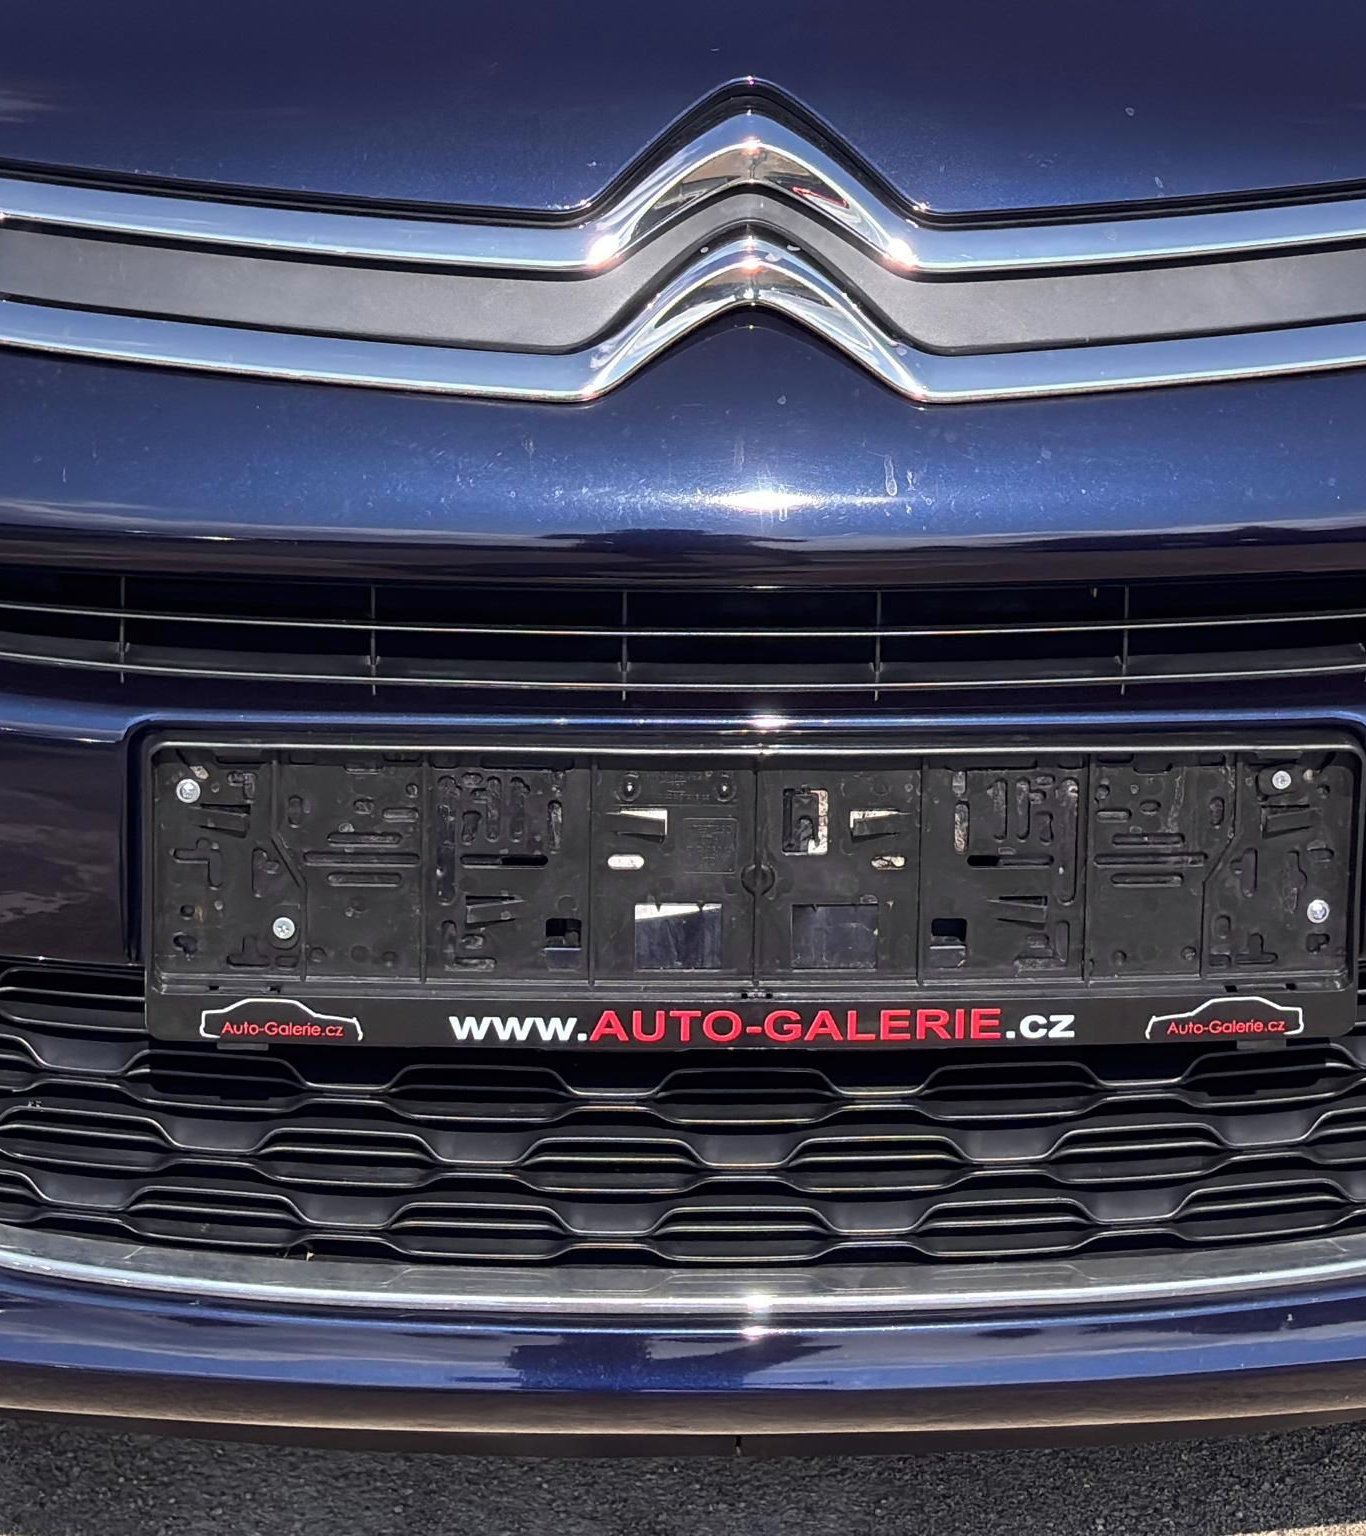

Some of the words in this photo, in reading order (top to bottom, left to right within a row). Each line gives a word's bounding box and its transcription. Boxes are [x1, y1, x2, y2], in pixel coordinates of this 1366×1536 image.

[221, 1021, 345, 1039] Auto-Galerie.cz
[448, 1007, 1076, 1045] www.AUTO-GALERIE.cz
[1166, 1018, 1287, 1037] Auto-Galerie.cz
